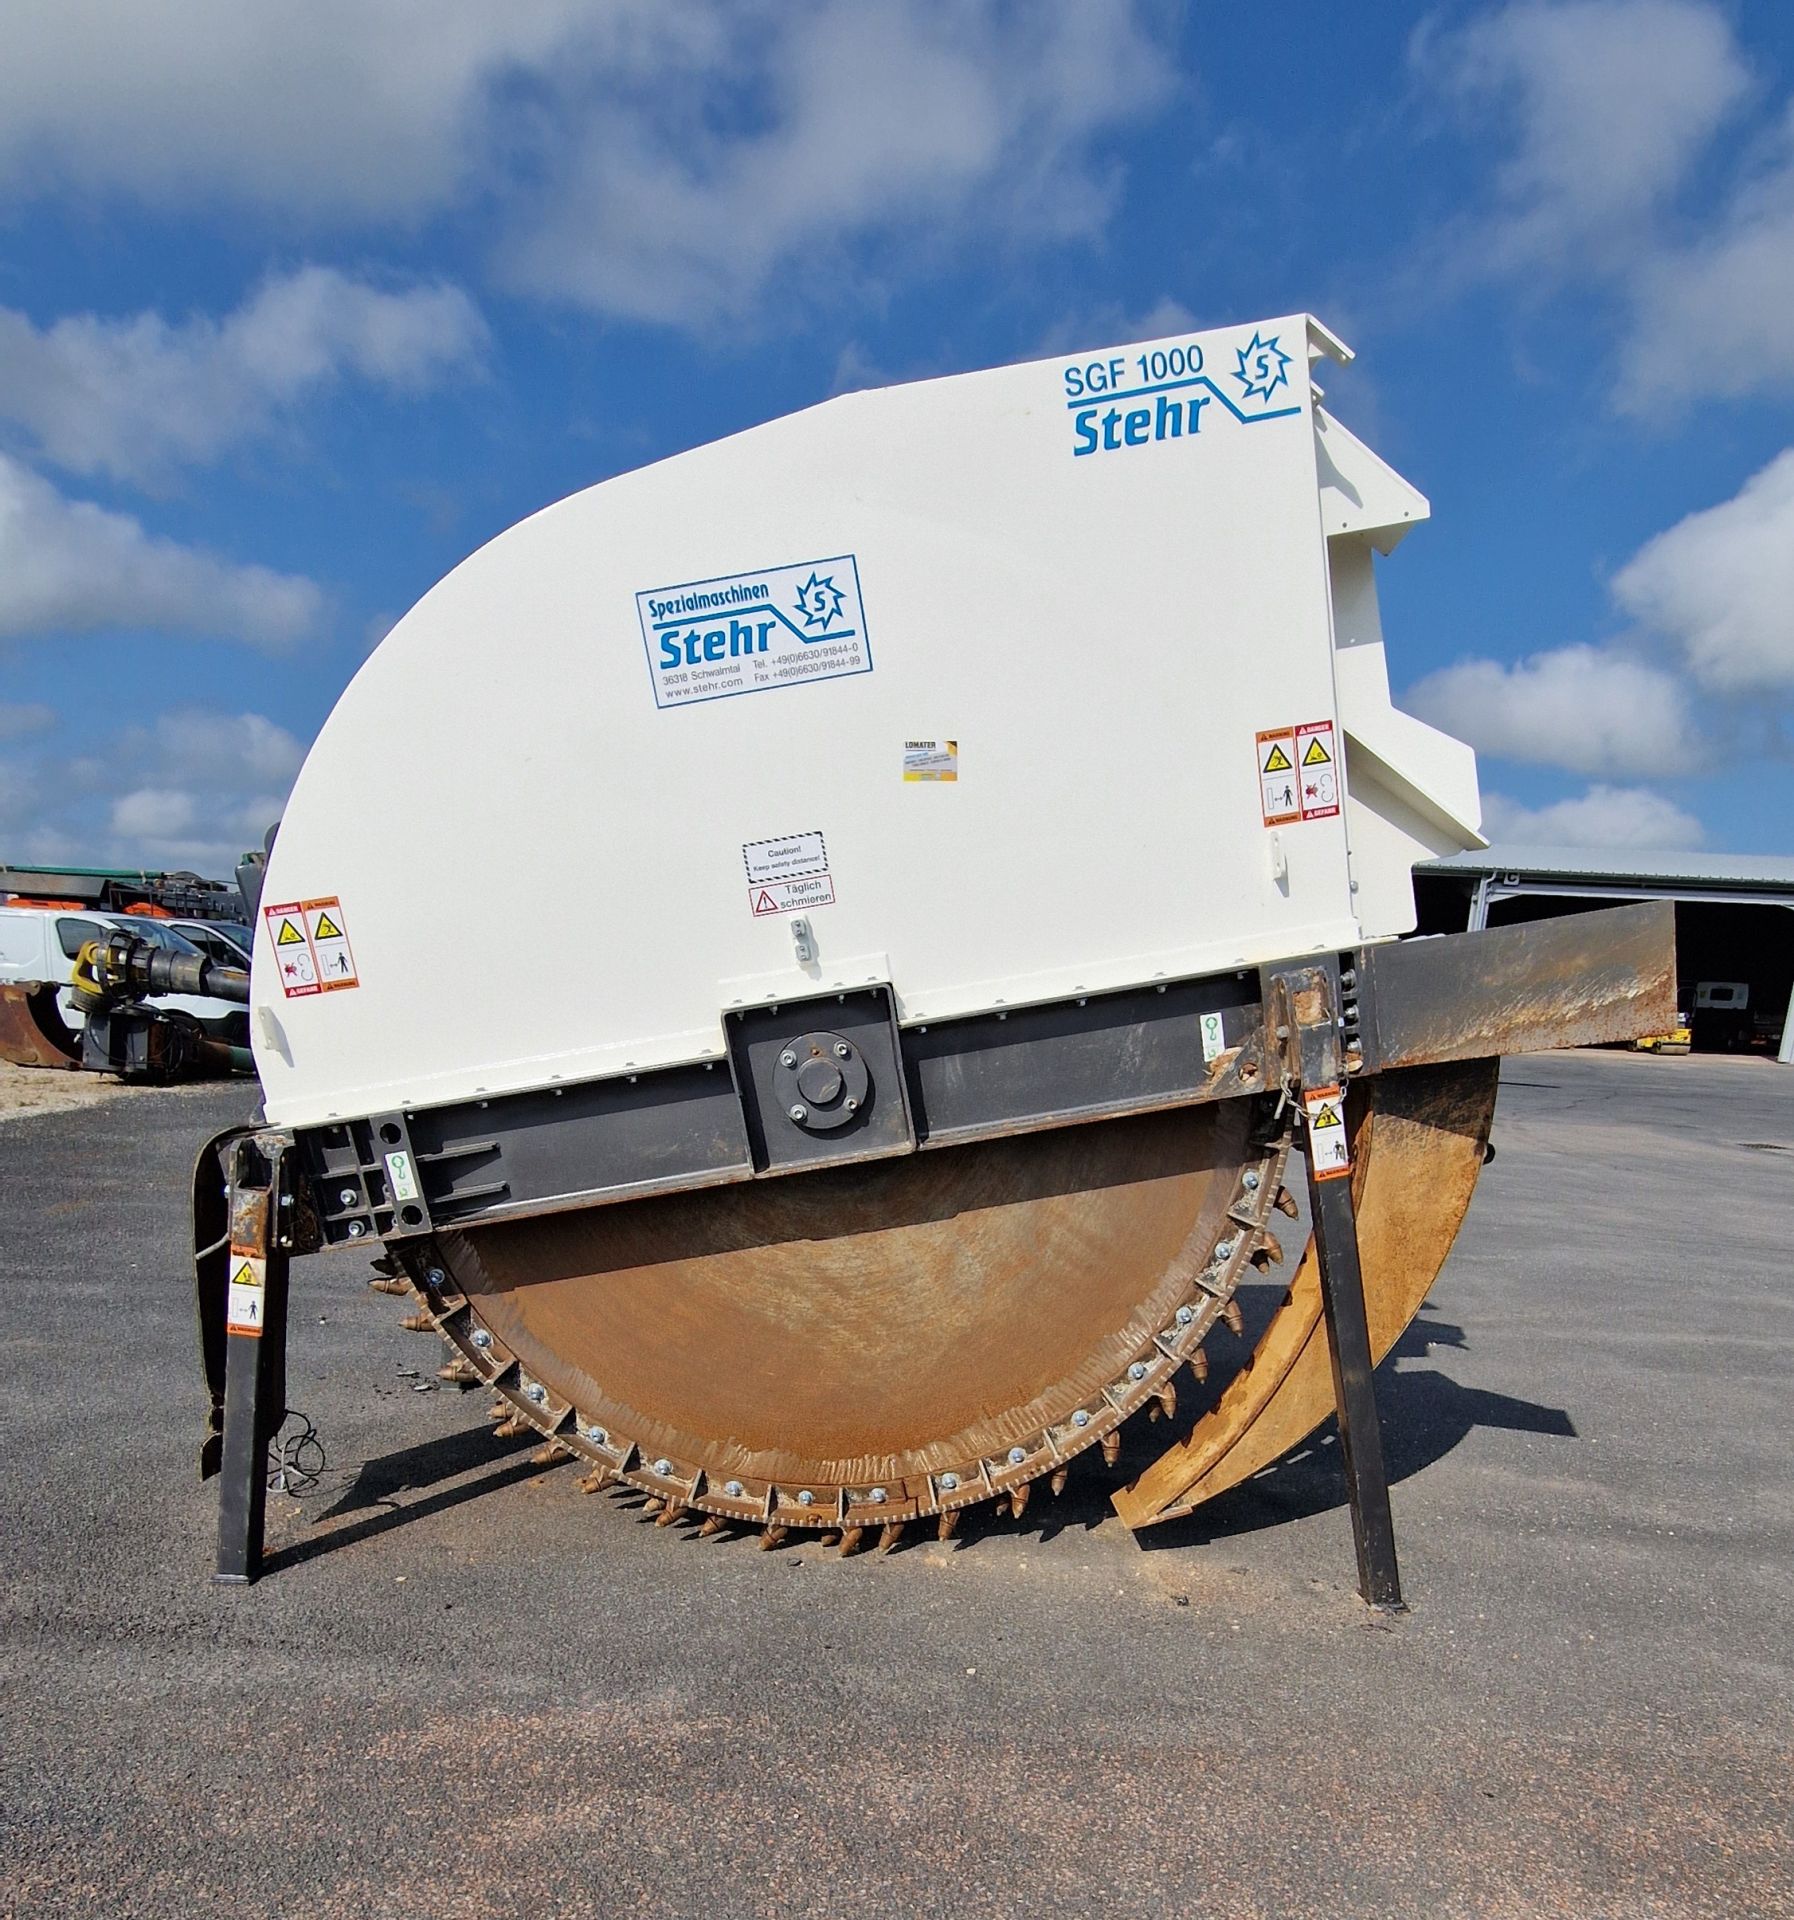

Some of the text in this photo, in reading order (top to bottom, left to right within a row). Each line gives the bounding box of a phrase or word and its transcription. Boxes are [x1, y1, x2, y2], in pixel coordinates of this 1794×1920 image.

[1064, 344, 1204, 396] SGF 1000
[1254, 354, 1269, 380] S
[1073, 395, 1211, 457] Stehr
[648, 583, 770, 620] Spezialmaschinen
[813, 590, 826, 612] S
[660, 619, 776, 669] Stehr
[662, 663, 741, 686] 36318 Schwalmtal
[752, 659, 768, 670] Tel.
[754, 672, 770, 683] Fax
[665, 678, 744, 698] www.stehr.com
[1307, 724, 1329, 732] DANGER
[768, 846, 801, 857] Caution!
[754, 864, 769, 872] Keep
[792, 856, 820, 865] distance!
[785, 880, 822, 895] Täglich
[780, 893, 832, 909] schmieren
